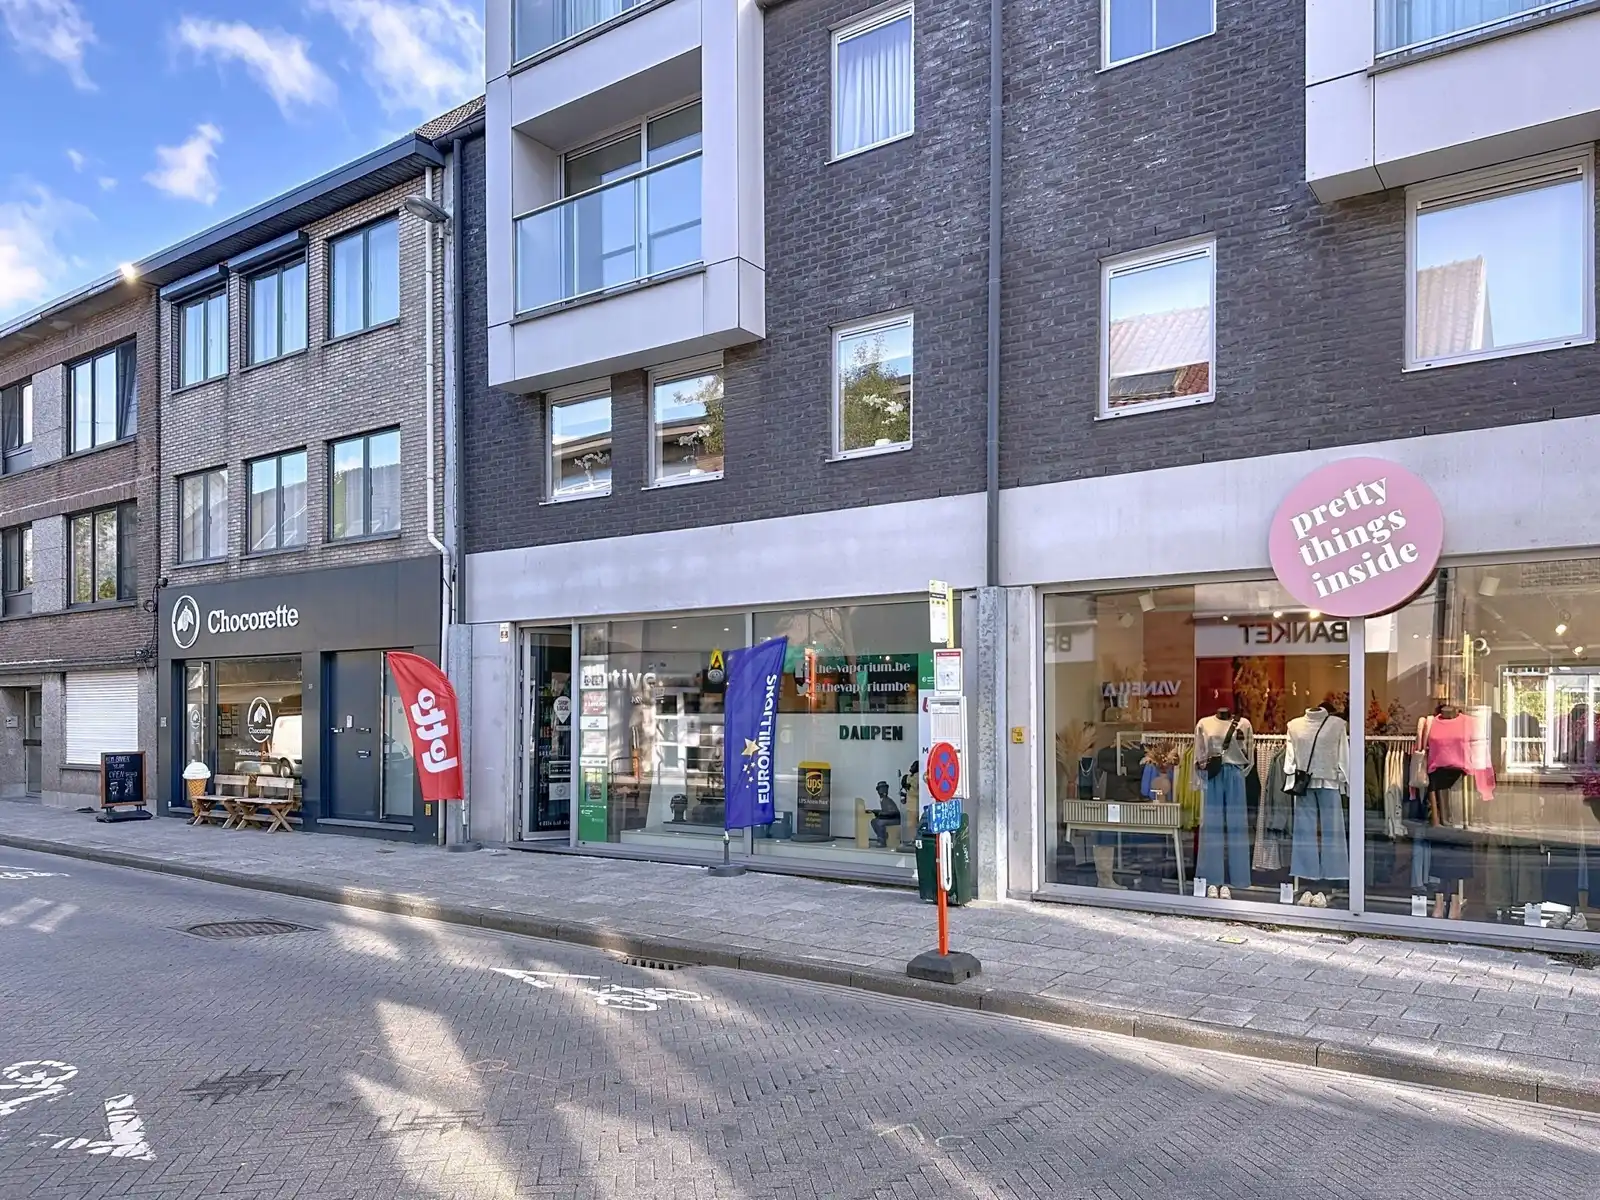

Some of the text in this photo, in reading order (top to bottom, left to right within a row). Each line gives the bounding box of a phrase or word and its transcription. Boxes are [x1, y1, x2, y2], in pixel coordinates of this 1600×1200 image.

[1290, 477, 1387, 541] pretty
[1298, 509, 1407, 567] things
[1311, 543, 1419, 599] inside
[207, 604, 299, 634] Chocorette
[757, 673, 778, 804] EUROMILLIONS
[807, 779, 821, 792] ups
